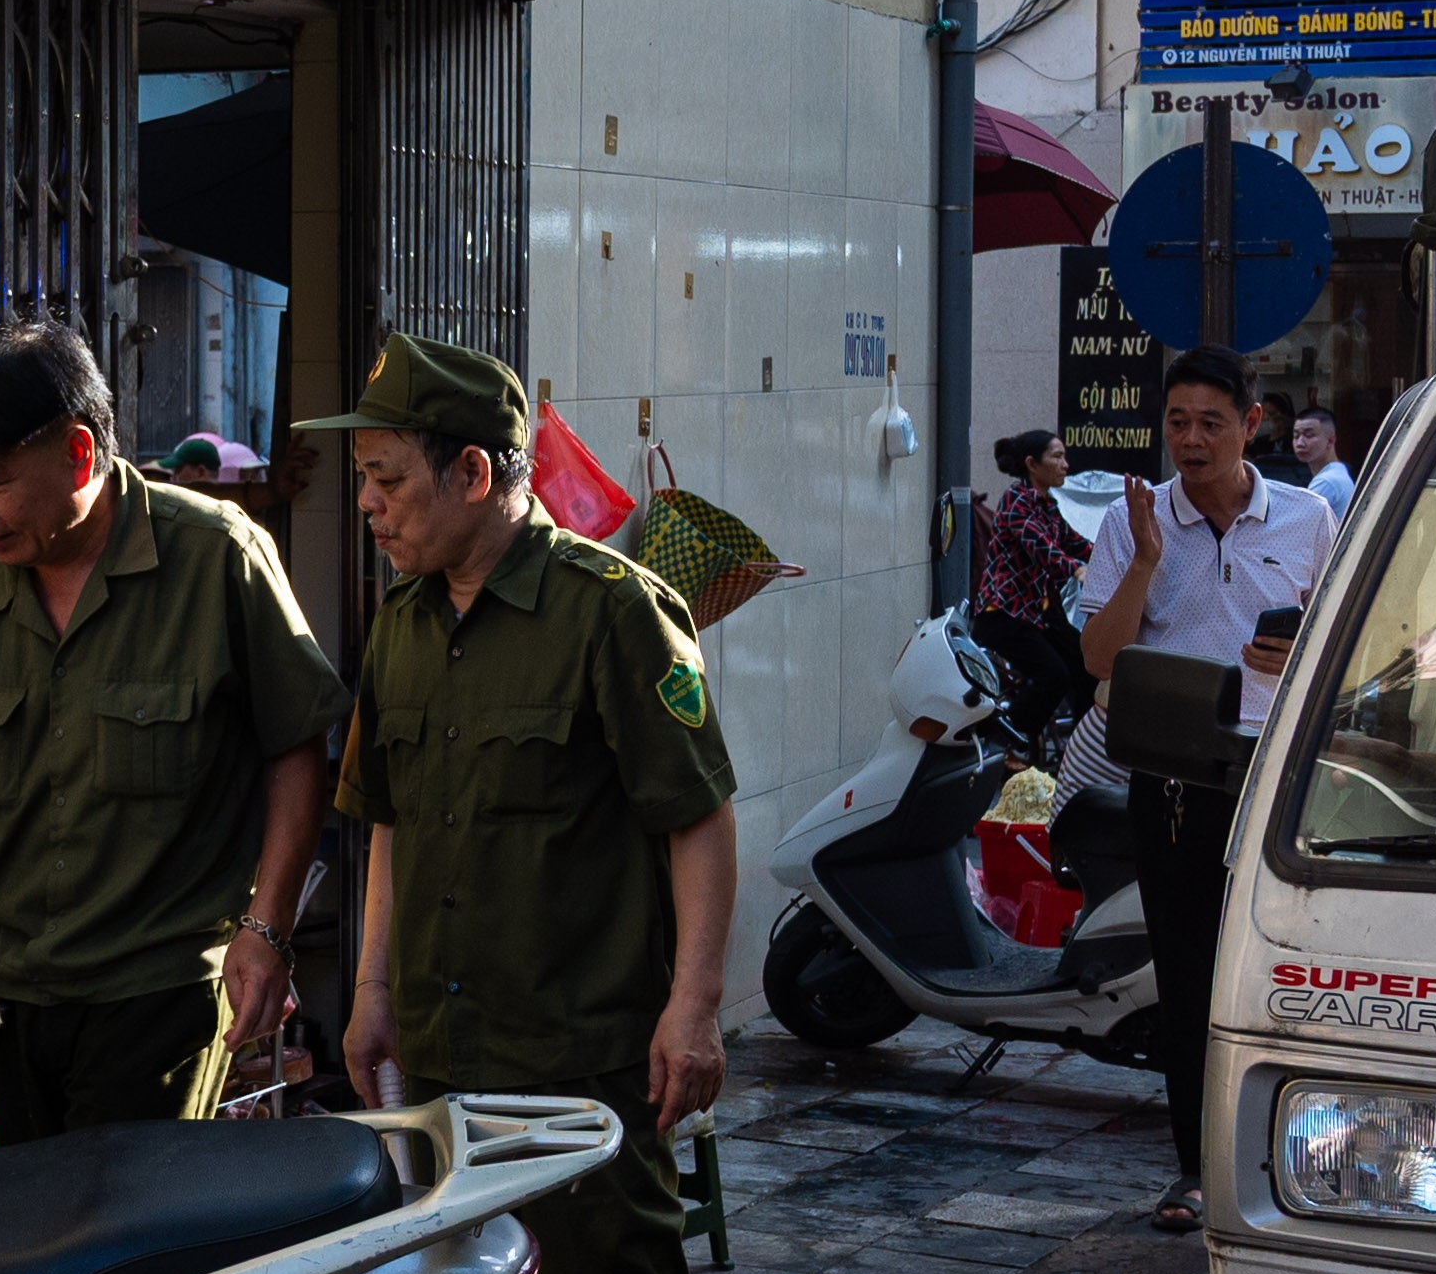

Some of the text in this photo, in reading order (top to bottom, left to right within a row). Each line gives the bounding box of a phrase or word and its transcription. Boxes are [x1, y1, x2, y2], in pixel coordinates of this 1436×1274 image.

[1180, 10, 1214, 39] BẢO
[1219, 11, 1279, 37] DƯỠNG
[1298, 8, 1348, 34] ĐÁNH
[1354, 7, 1404, 31] BÓNG
[1179, 41, 1352, 64] 12 NGUYỄN THIỆN THUẬT
[1341, 186, 1395, 208] THUẬT
[1079, 375, 1141, 413] GỘI ĐẦU
